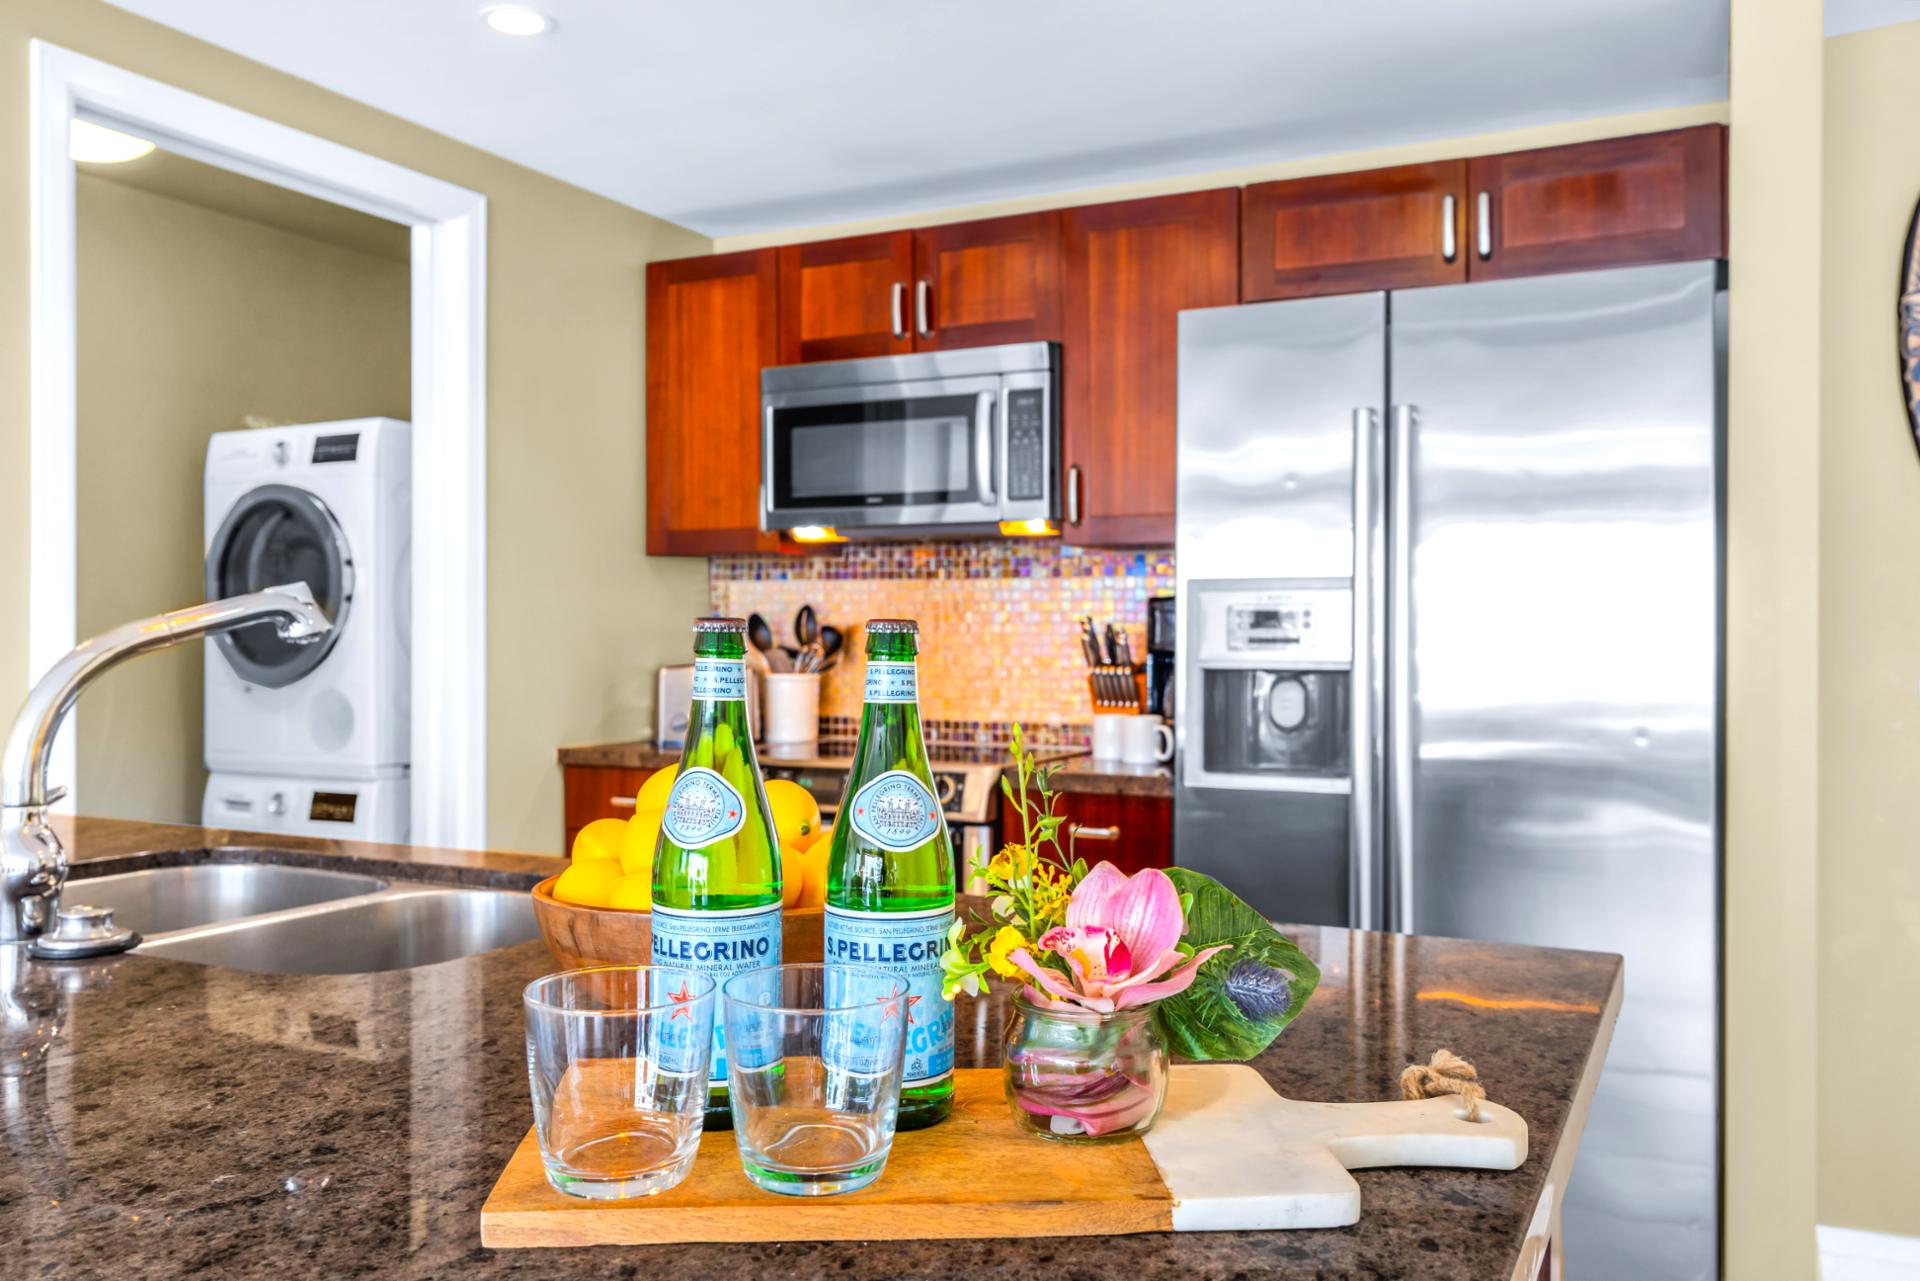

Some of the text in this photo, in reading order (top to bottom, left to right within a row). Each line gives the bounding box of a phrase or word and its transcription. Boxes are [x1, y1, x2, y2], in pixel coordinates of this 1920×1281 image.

[652, 932, 769, 961] ELLEGRINO
[827, 935, 952, 962] S.PELLEGRIN
[696, 963, 733, 972] MINERAL
[736, 960, 761, 970] WATER
